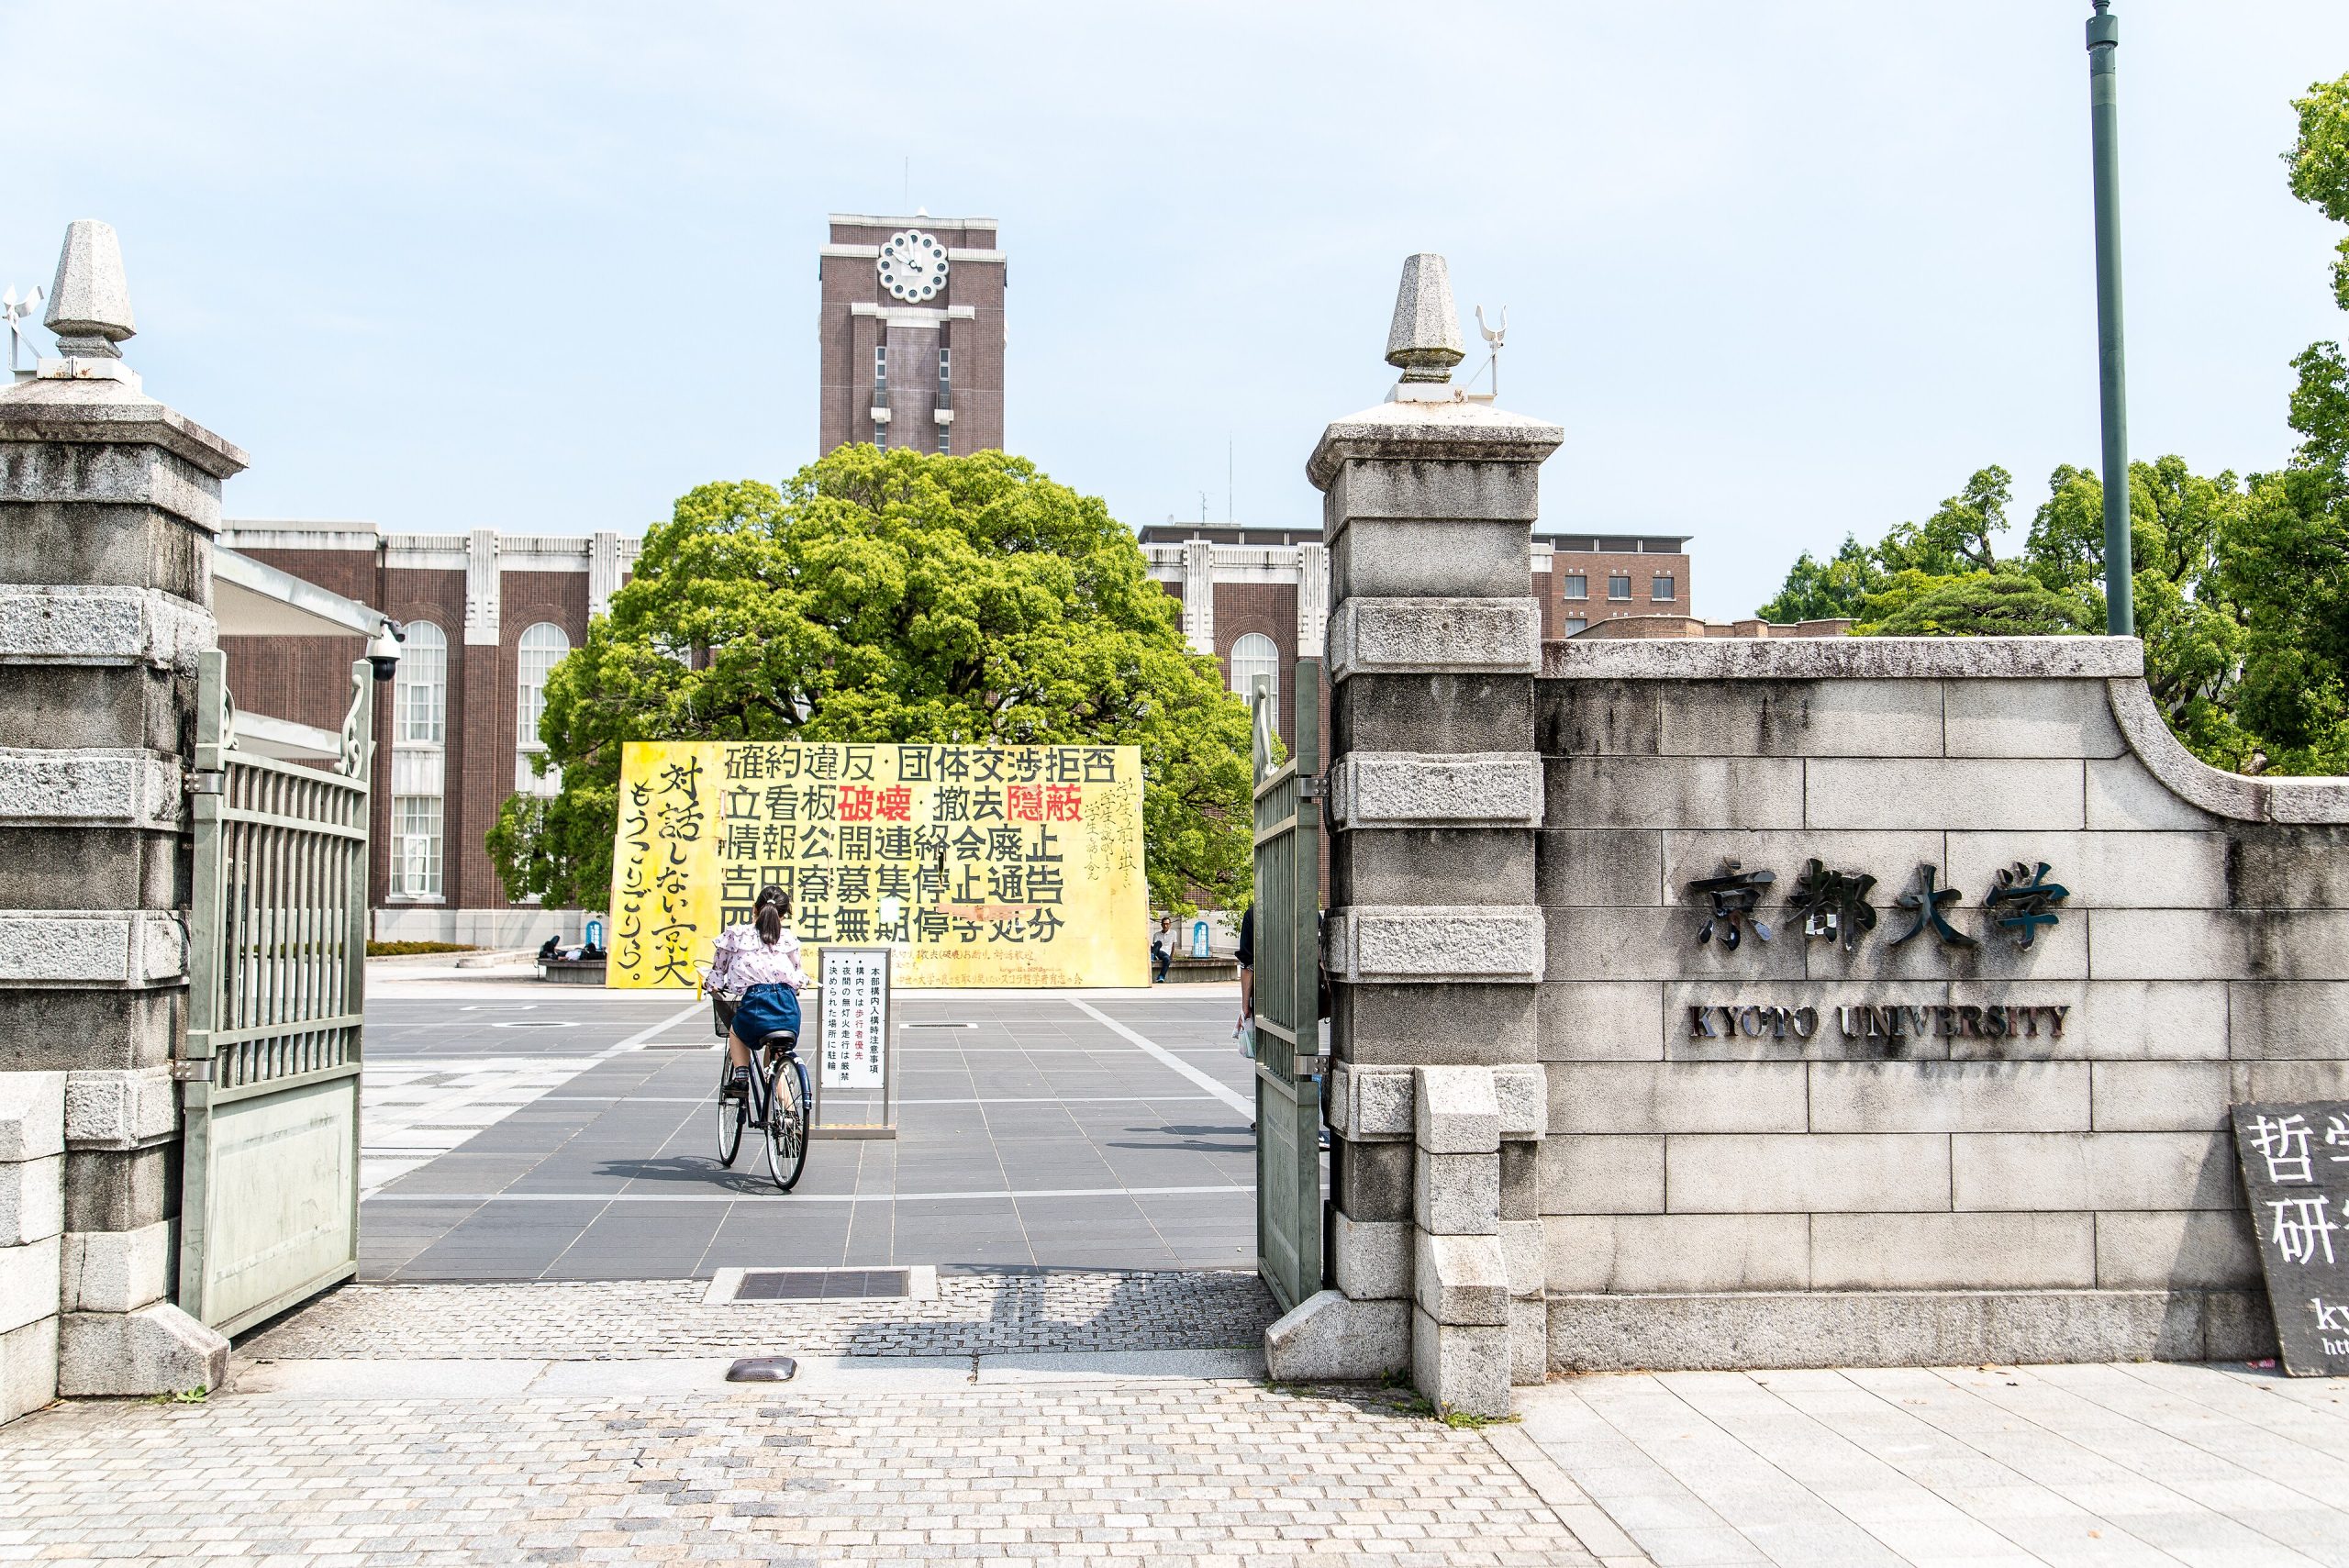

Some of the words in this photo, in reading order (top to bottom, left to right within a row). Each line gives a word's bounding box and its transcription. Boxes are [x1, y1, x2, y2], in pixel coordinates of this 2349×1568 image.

[651, 755, 704, 986] 対話しない京大
[726, 823, 1063, 862] 情報公開連絡会廃止
[720, 863, 1064, 905] 吉田寮募集停止通告
[1688, 856, 2071, 951] 京都大学
[720, 906, 1065, 943] 四生無期停学処分
[869, 967, 881, 1074] 本部構内入構時注意事項
[1689, 1005, 1820, 1039] KYOTO
[1836, 1005, 2071, 1039] UNIVERSITY
[2266, 1195, 2349, 1265] 研
